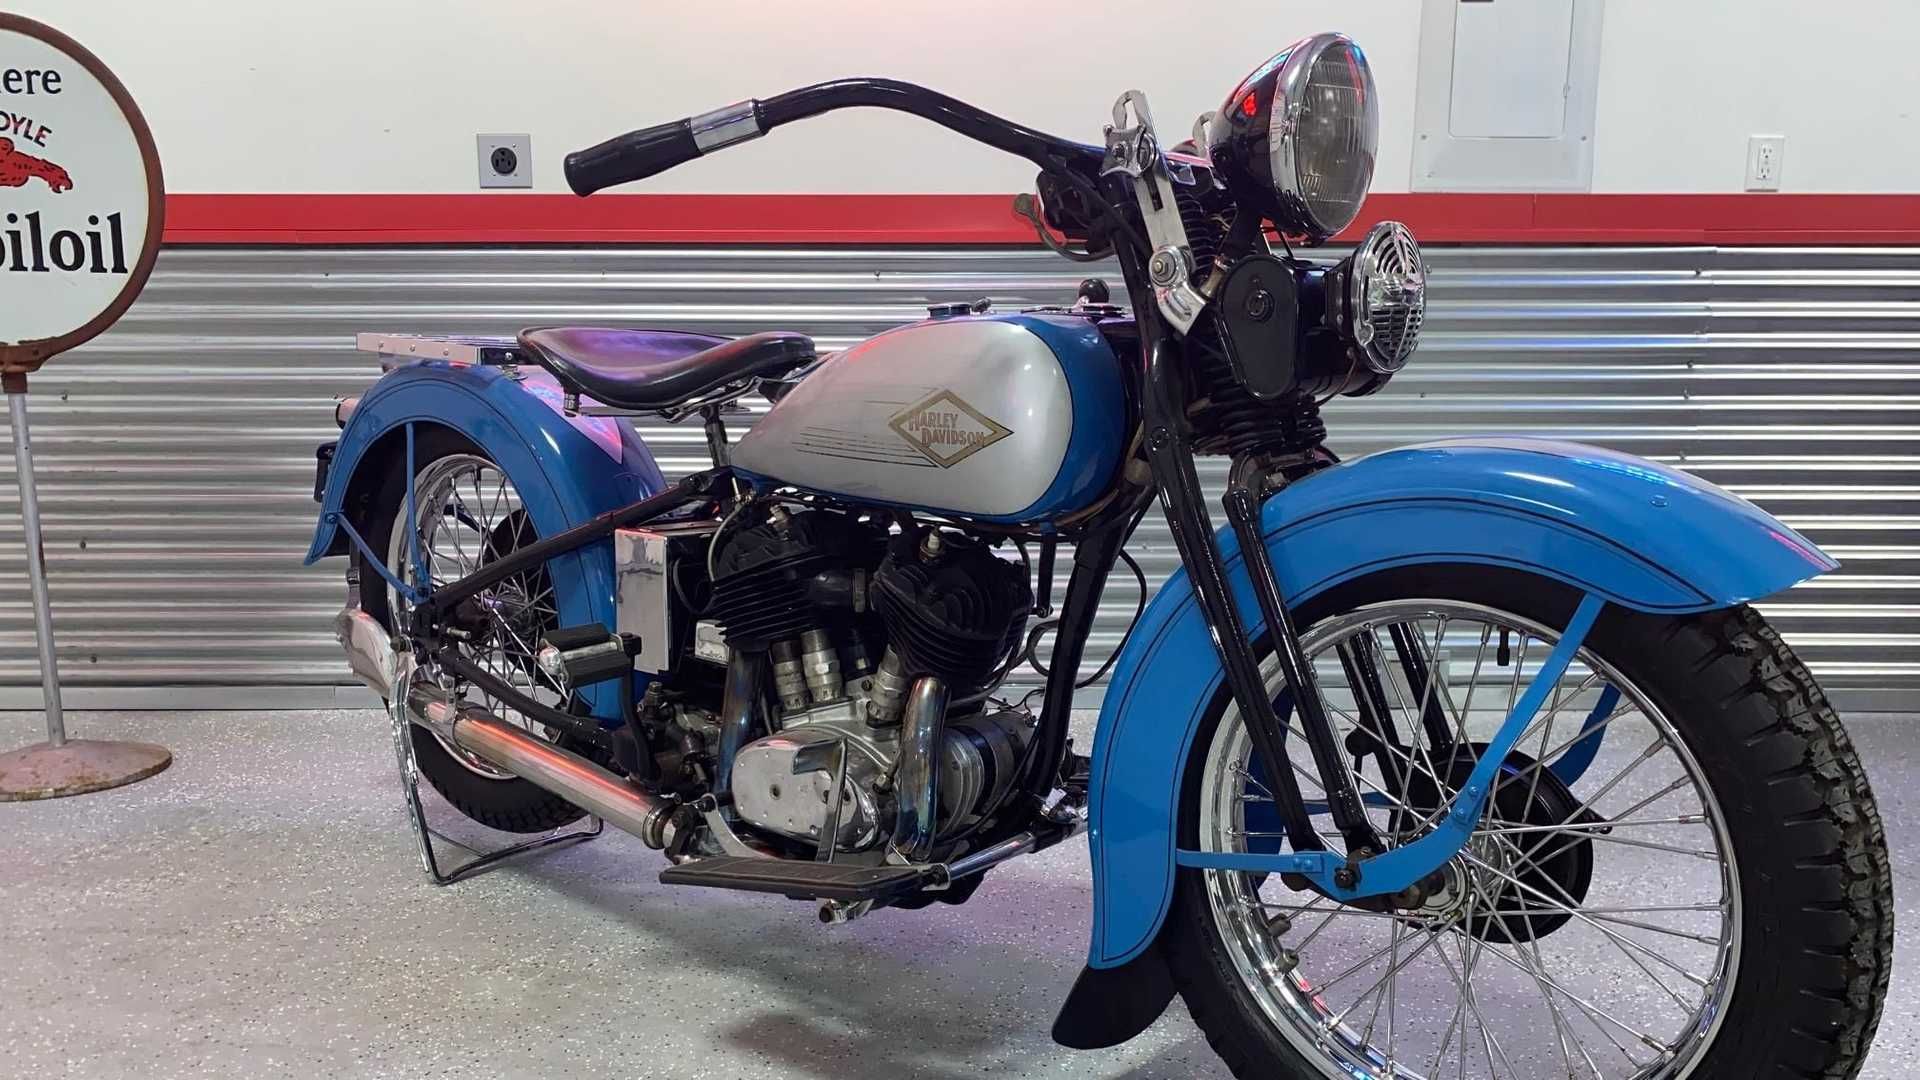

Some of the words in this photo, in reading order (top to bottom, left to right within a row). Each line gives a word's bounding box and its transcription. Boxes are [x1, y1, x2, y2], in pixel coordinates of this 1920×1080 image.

[0, 69, 62, 95] ere
[0, 210, 128, 274] iloil
[908, 411, 959, 431] HARLEY
[921, 428, 985, 448] DAVIDSON
